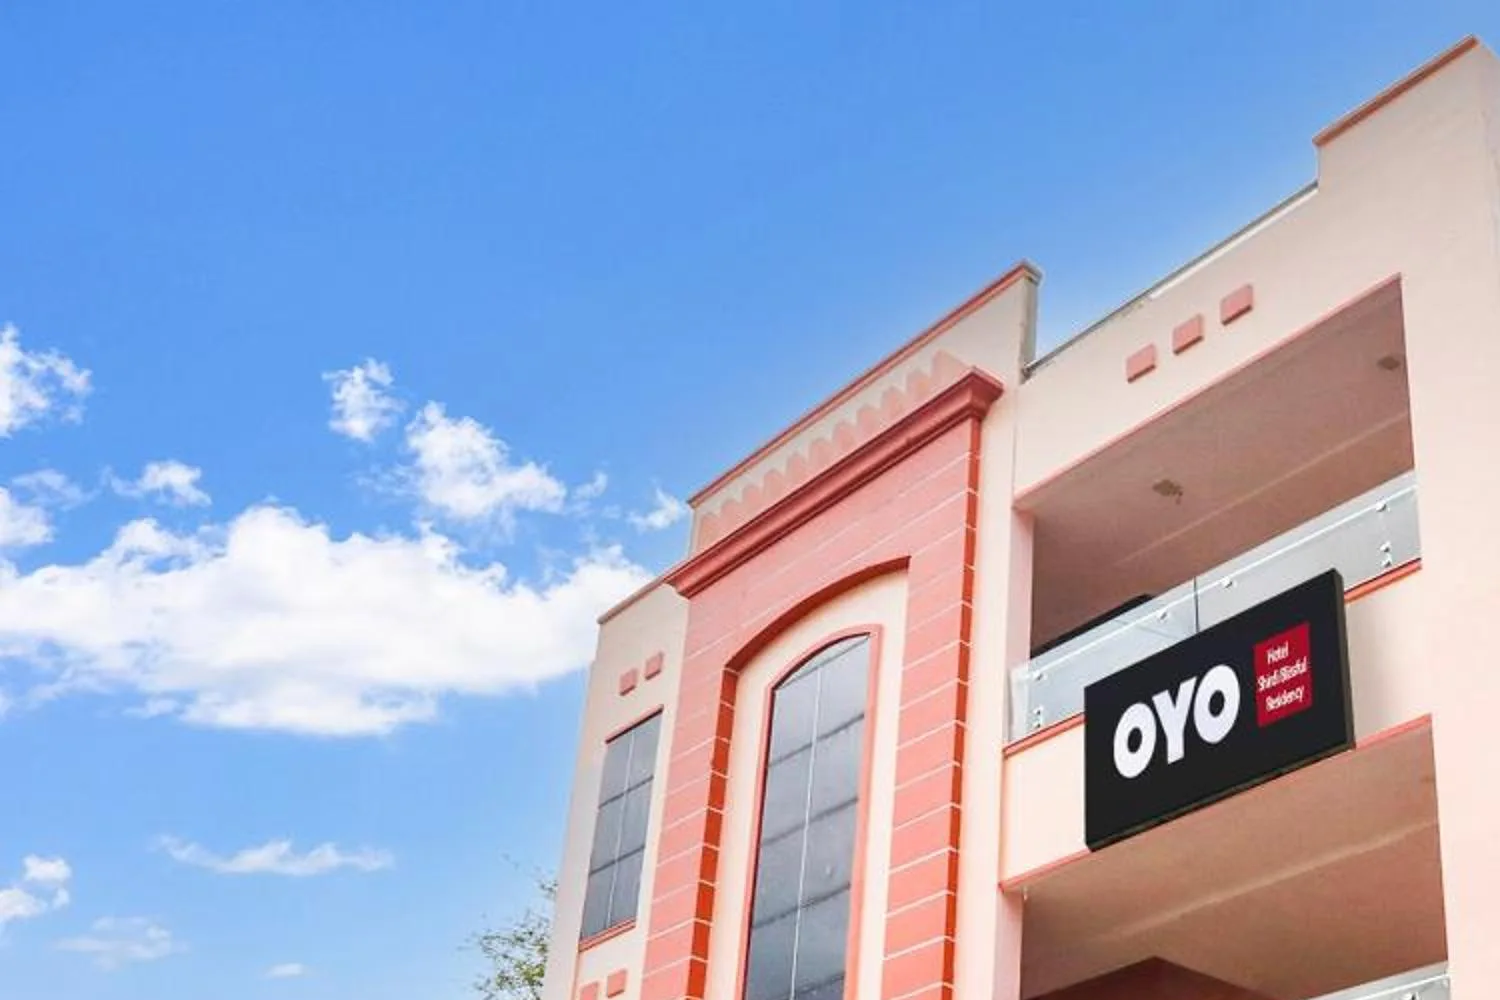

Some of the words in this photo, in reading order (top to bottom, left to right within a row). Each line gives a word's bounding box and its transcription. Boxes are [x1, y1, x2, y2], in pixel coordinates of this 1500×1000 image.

[1266, 641, 1289, 665] Hotel
[1265, 685, 1304, 712] Residency
[1113, 664, 1241, 779] OYO
